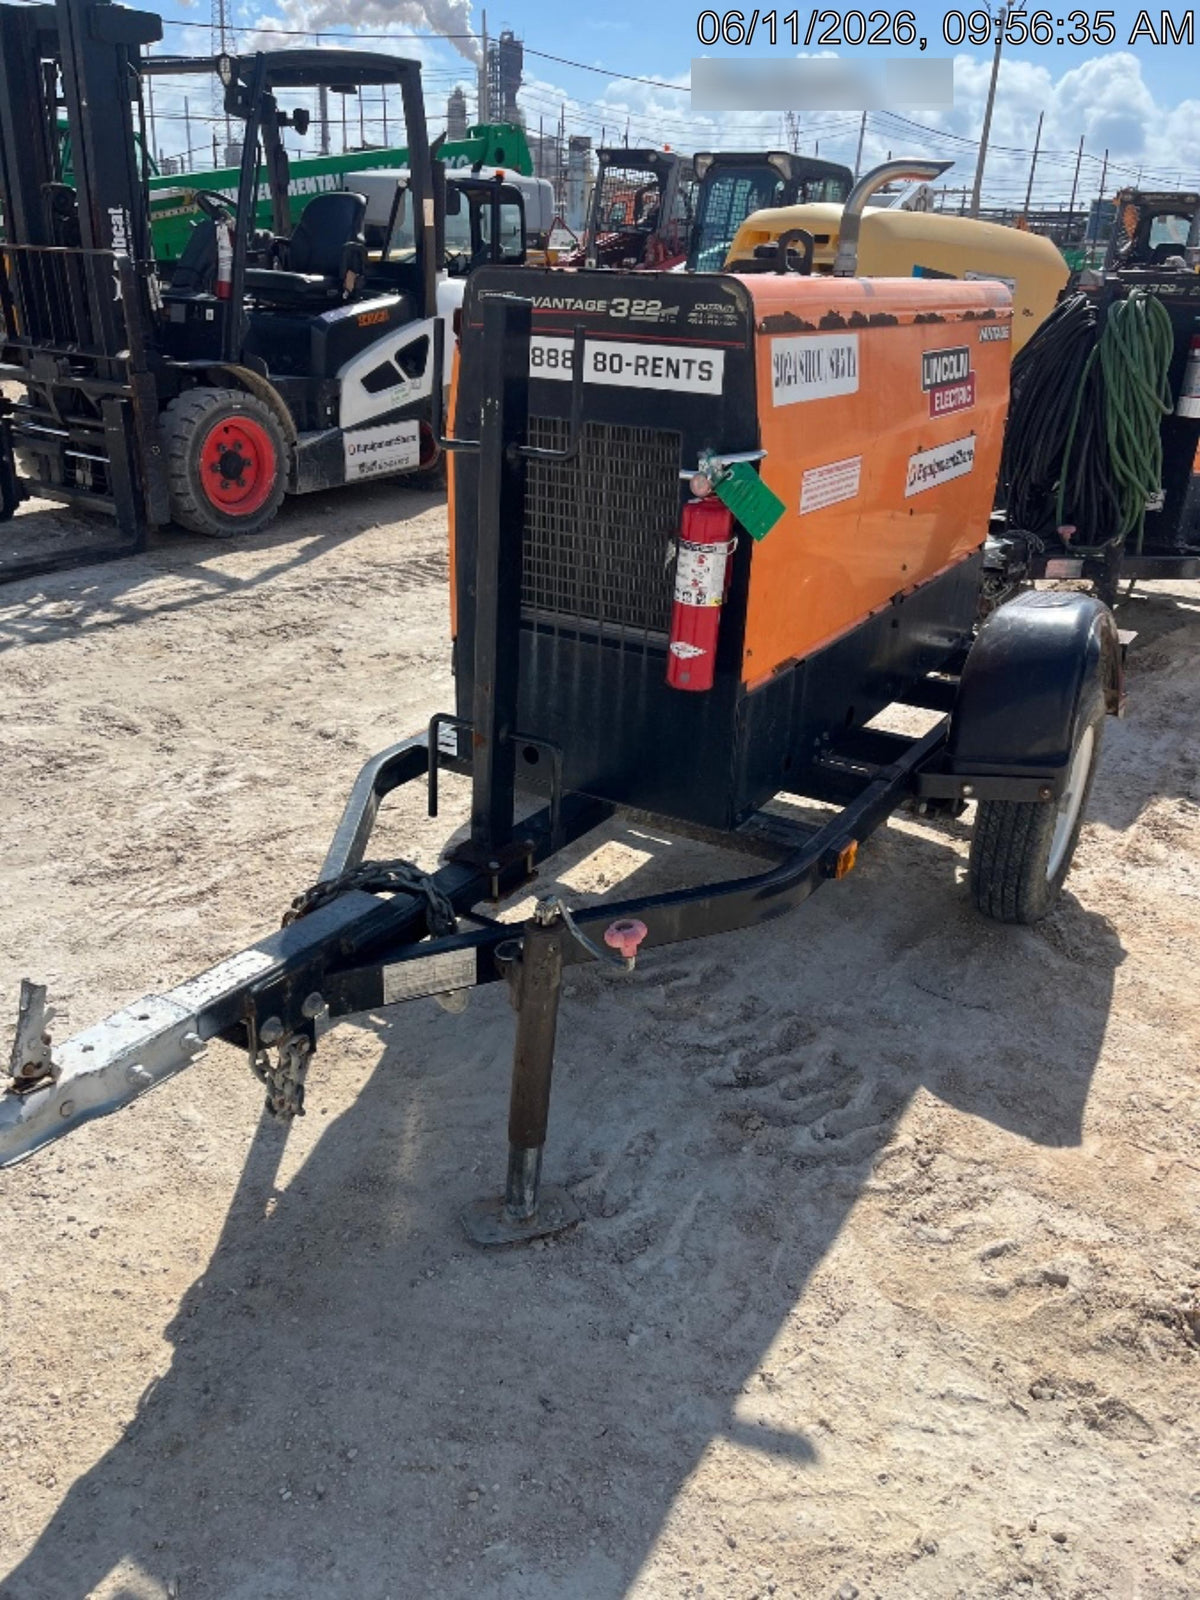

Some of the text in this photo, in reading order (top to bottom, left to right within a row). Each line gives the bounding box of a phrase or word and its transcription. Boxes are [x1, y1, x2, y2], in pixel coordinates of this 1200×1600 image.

[531, 296, 662, 318] VANTAGE 322
[531, 346, 714, 382] 888 80-RENTS
[924, 353, 968, 385] LINCOLN
[935, 385, 971, 411] ELECTRIC
